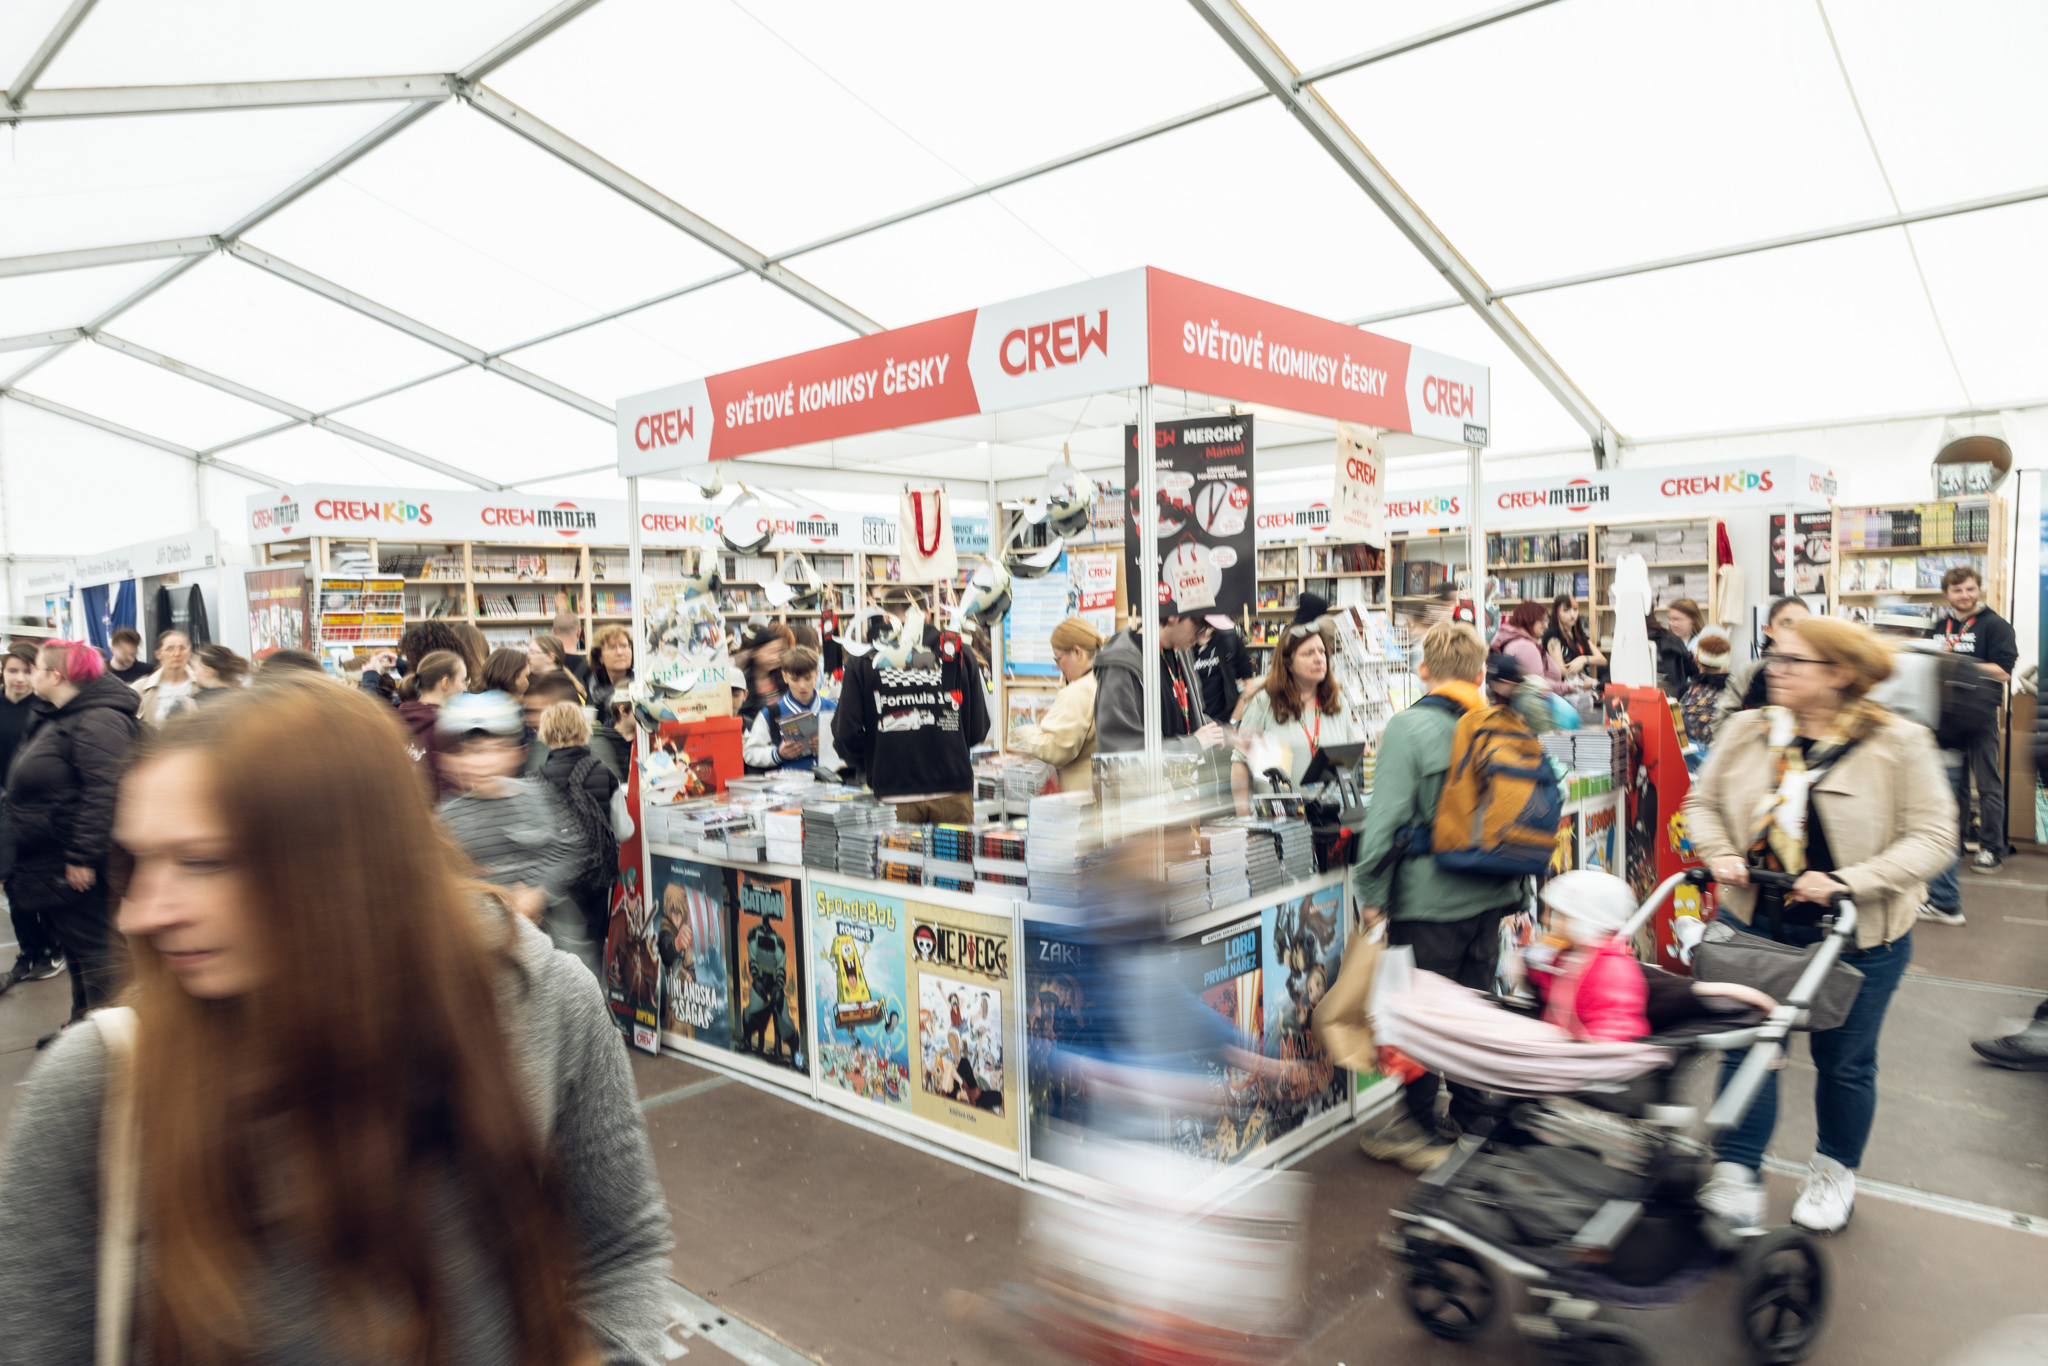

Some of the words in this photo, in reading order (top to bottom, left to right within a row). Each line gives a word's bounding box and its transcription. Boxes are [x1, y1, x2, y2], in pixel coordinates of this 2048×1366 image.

[999, 309, 1108, 377] CREW
[1183, 318, 1264, 370] SVĚTOVÉ
[1268, 342, 1338, 386] KOMIKSY
[1341, 353, 1388, 397] ČESKY
[725, 381, 795, 429] SVĚTOVÉ
[799, 369, 879, 413] KOMIKSY
[883, 353, 950, 396] ČESKY
[1423, 375, 1474, 420] CREW
[635, 406, 694, 451] CREW
[1347, 457, 1376, 487] CREW
[1498, 490, 1547, 509] CREW
[1550, 485, 1609, 505] MANGA
[1661, 475, 1720, 497] CREW
[253, 506, 273, 530] CREW
[314, 500, 380, 521] CREW
[481, 507, 535, 526] CREW
[537, 510, 597, 528] MANGA
[641, 514, 686, 531] CREW
[1257, 513, 1294, 529] CREW
[797, 520, 838, 537] MANGA
[880, 691, 936, 707] Formula
[740, 886, 786, 918] BATMAN
[1225, 930, 1256, 962] LOBO
[1204, 961, 1230, 987] PRVNÍ
[1230, 953, 1257, 977] NÁŘEZ
